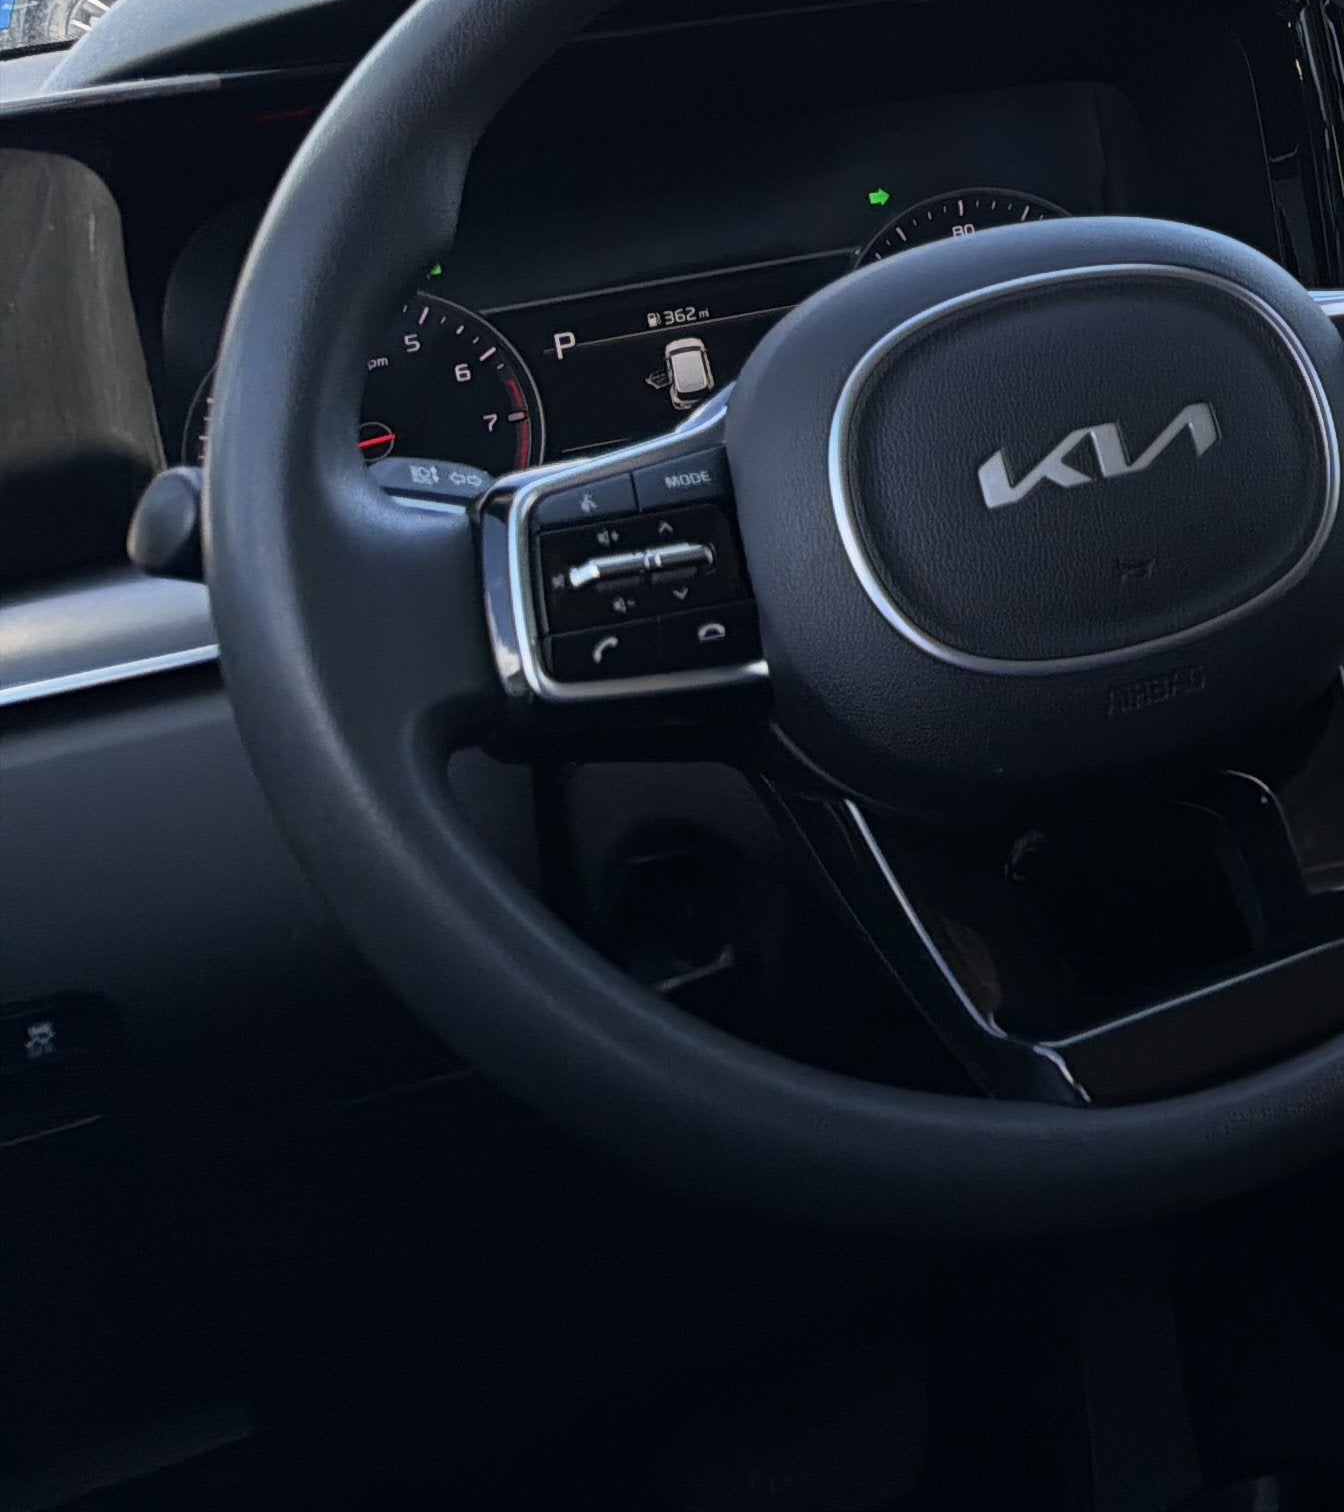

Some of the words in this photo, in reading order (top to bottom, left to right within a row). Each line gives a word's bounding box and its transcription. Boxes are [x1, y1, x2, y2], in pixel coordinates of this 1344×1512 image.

[662, 306, 698, 326] 362
[699, 307, 711, 320] mi
[403, 333, 422, 354] 5
[553, 330, 577, 361] P
[367, 356, 390, 371] pm
[454, 363, 472, 383] 6
[482, 413, 499, 433] 7
[977, 401, 1222, 509] KIA
[664, 470, 713, 489] MODE
